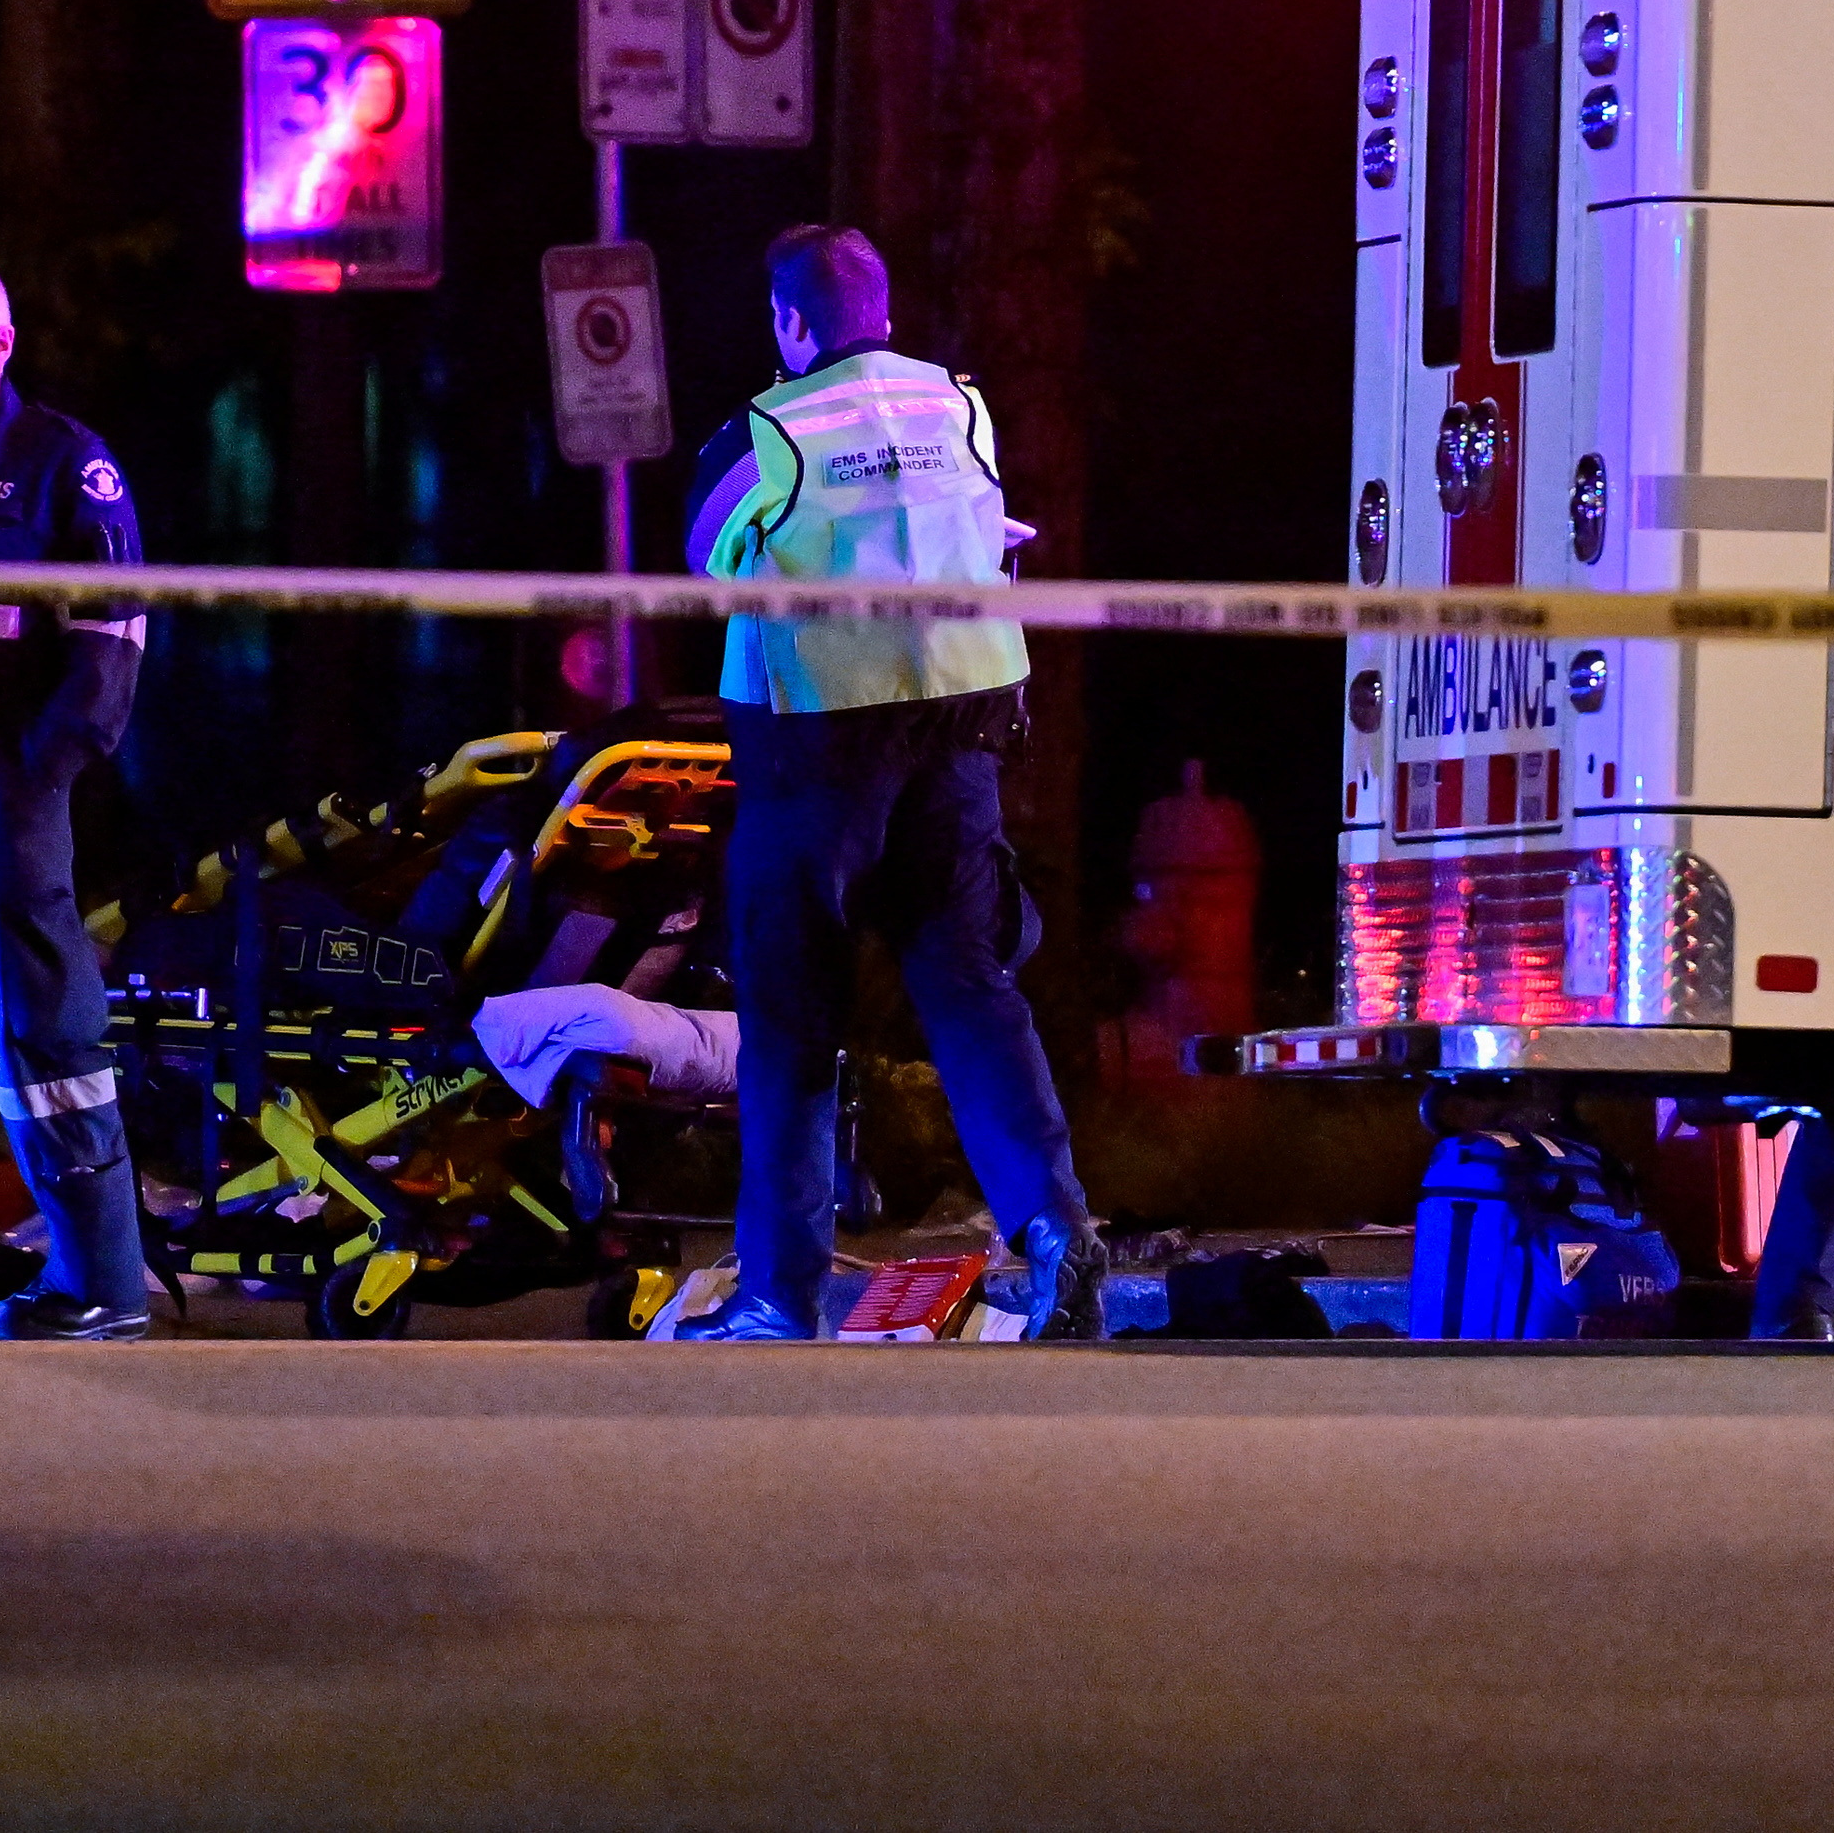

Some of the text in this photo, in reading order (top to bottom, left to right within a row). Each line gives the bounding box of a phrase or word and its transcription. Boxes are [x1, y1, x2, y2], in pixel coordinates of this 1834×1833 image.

[831, 445, 943, 468] EMS INCIDENT
[838, 458, 944, 481] COMMANDER
[1405, 633, 1556, 739] AMBULANCE
